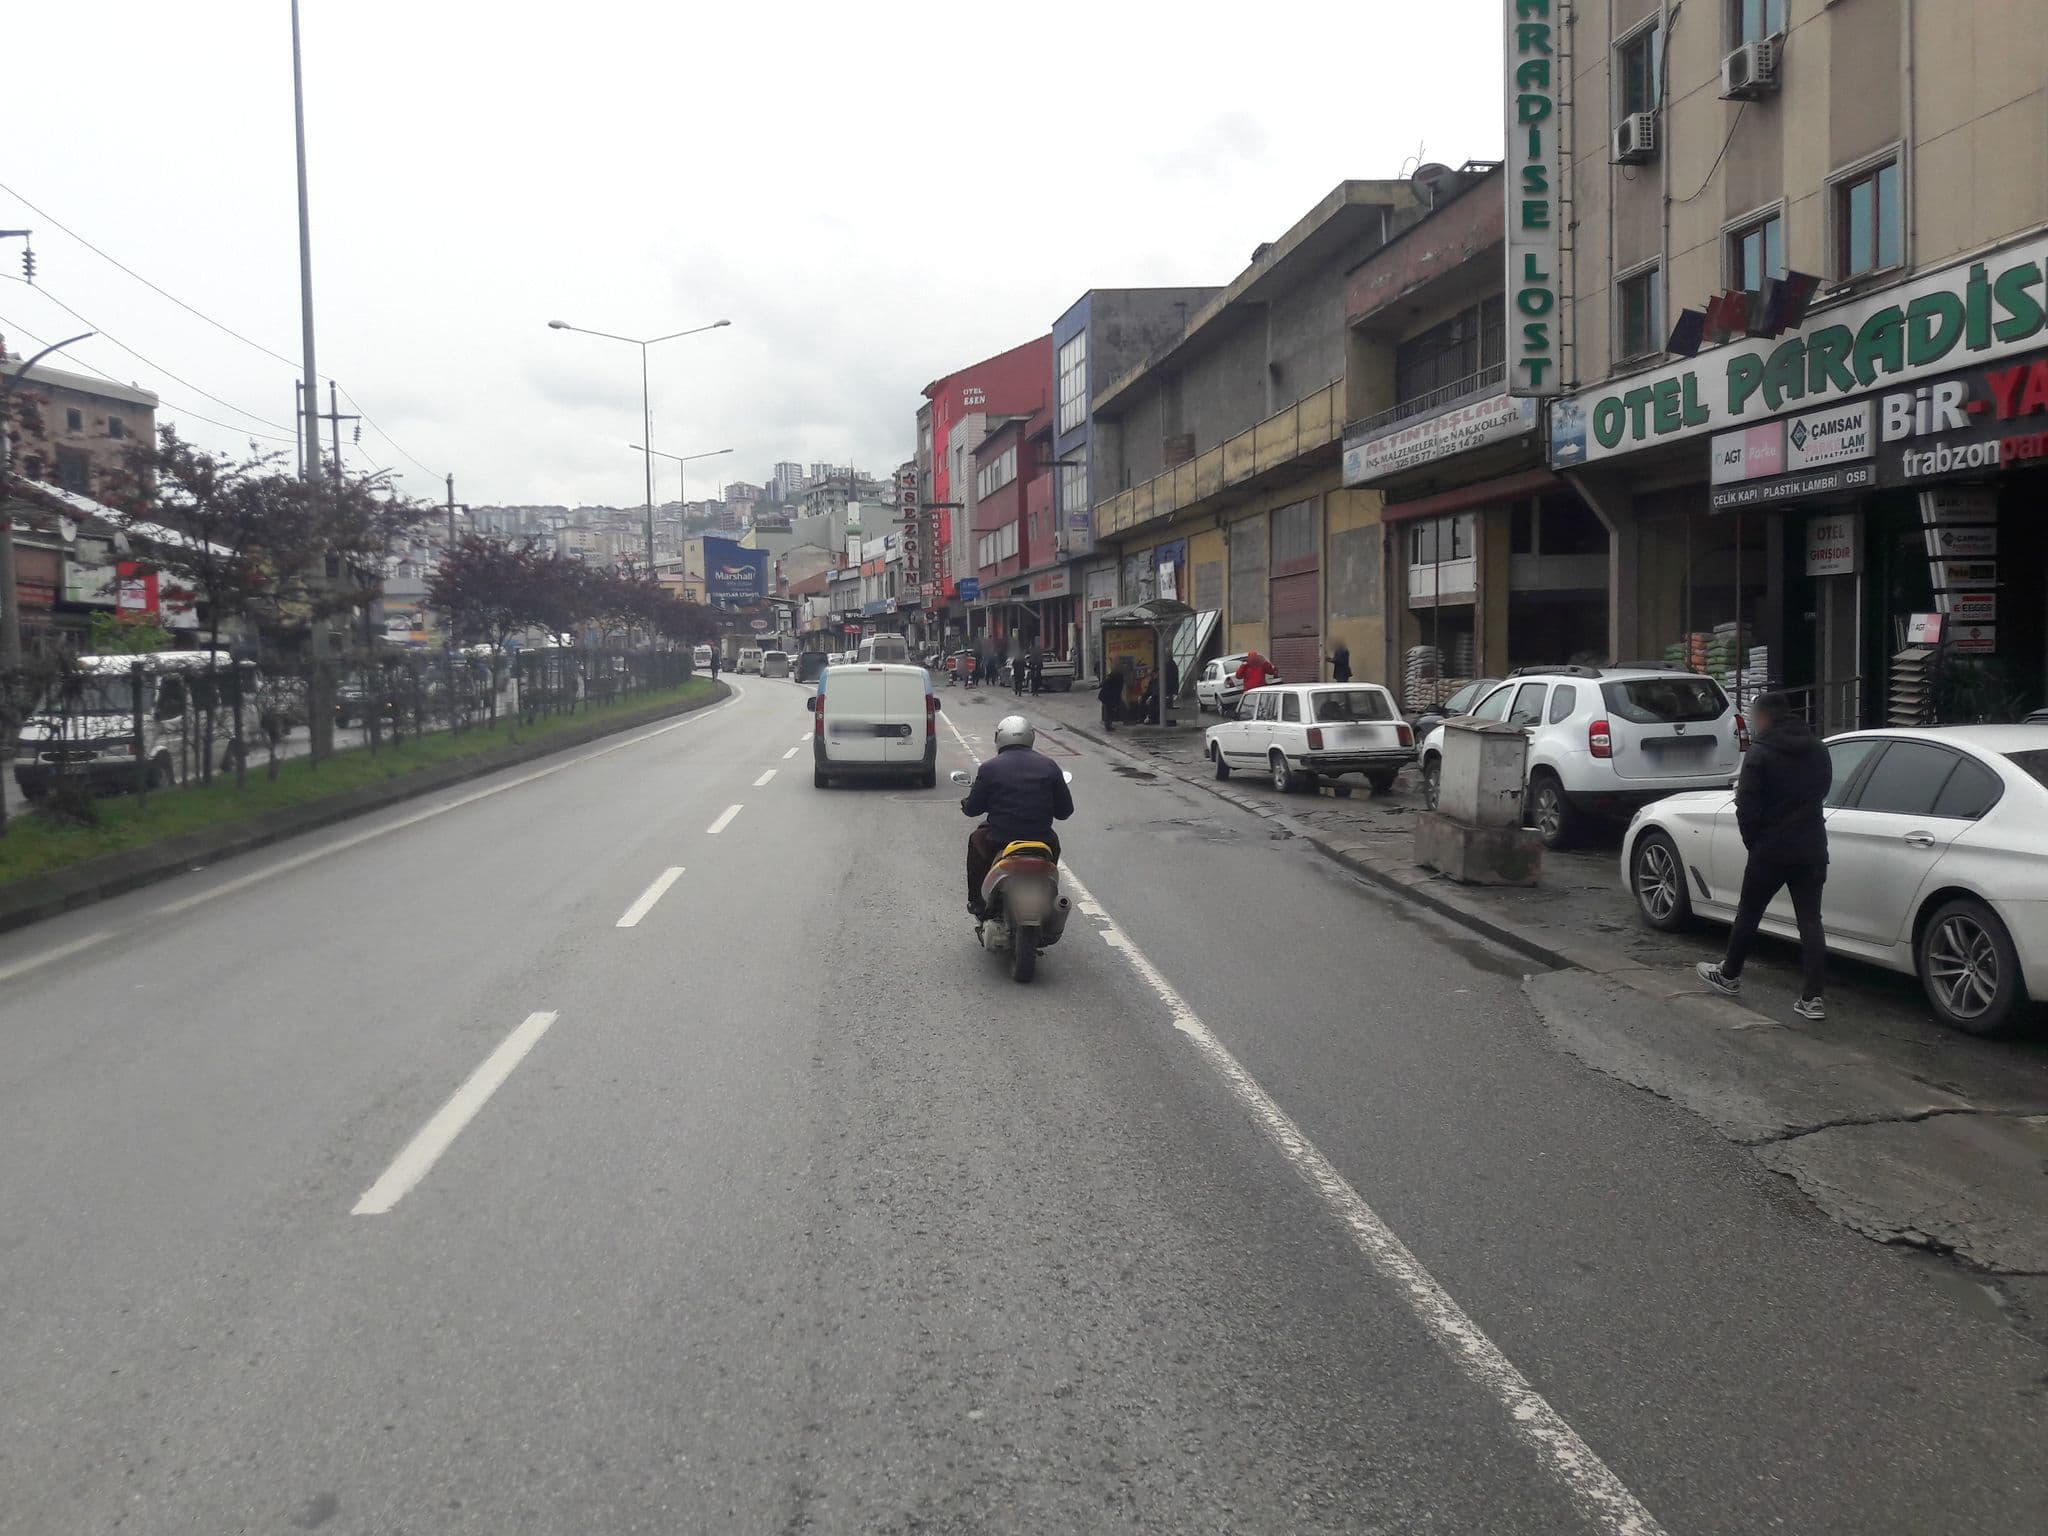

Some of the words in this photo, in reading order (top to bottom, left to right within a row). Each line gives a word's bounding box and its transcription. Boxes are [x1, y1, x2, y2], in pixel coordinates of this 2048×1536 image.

[1518, 253, 1554, 386] LOST
[1593, 372, 1711, 449] OTEL
[1726, 257, 2048, 416] PARADİS
[963, 387, 983, 395] OTEL
[964, 395, 985, 405] ESEN
[1811, 414, 1862, 439] ÇAMSAN
[1724, 449, 1741, 465] AGT
[1713, 493, 1737, 508] ÇELİK
[1738, 489, 1758, 502] KAPI
[1763, 481, 1800, 498] PLASTİK
[1802, 474, 1838, 491] LAMBRİ
[1846, 470, 1867, 484] OSB
[1817, 525, 1845, 541] OTEL
[715, 571, 753, 580] Marshall
